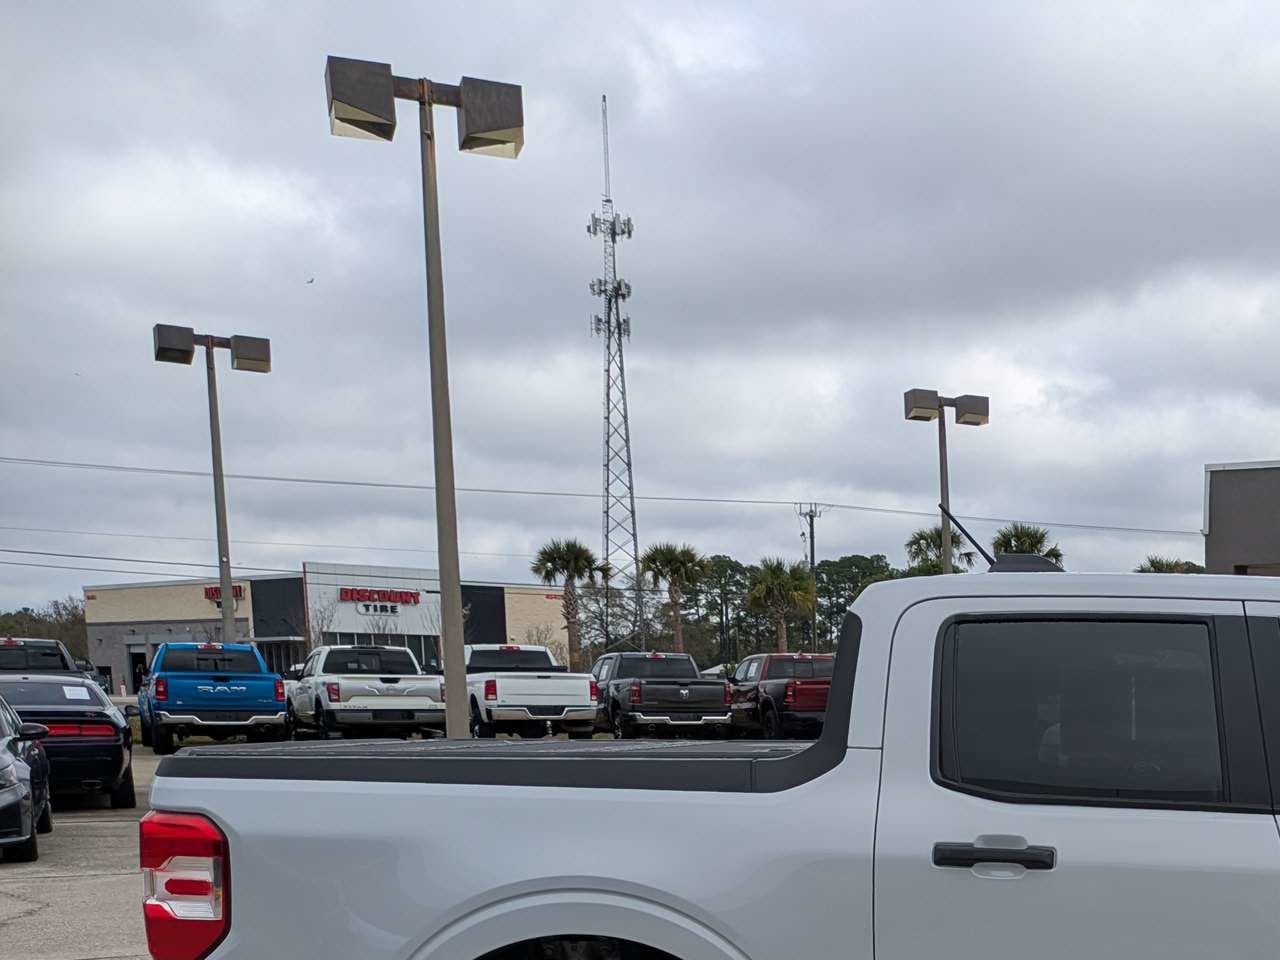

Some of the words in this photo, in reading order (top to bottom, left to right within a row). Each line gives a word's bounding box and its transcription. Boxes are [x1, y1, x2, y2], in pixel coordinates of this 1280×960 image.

[340, 587, 420, 605] DISCOUNT
[362, 604, 399, 614] TIRE
[197, 685, 247, 694] RAM
